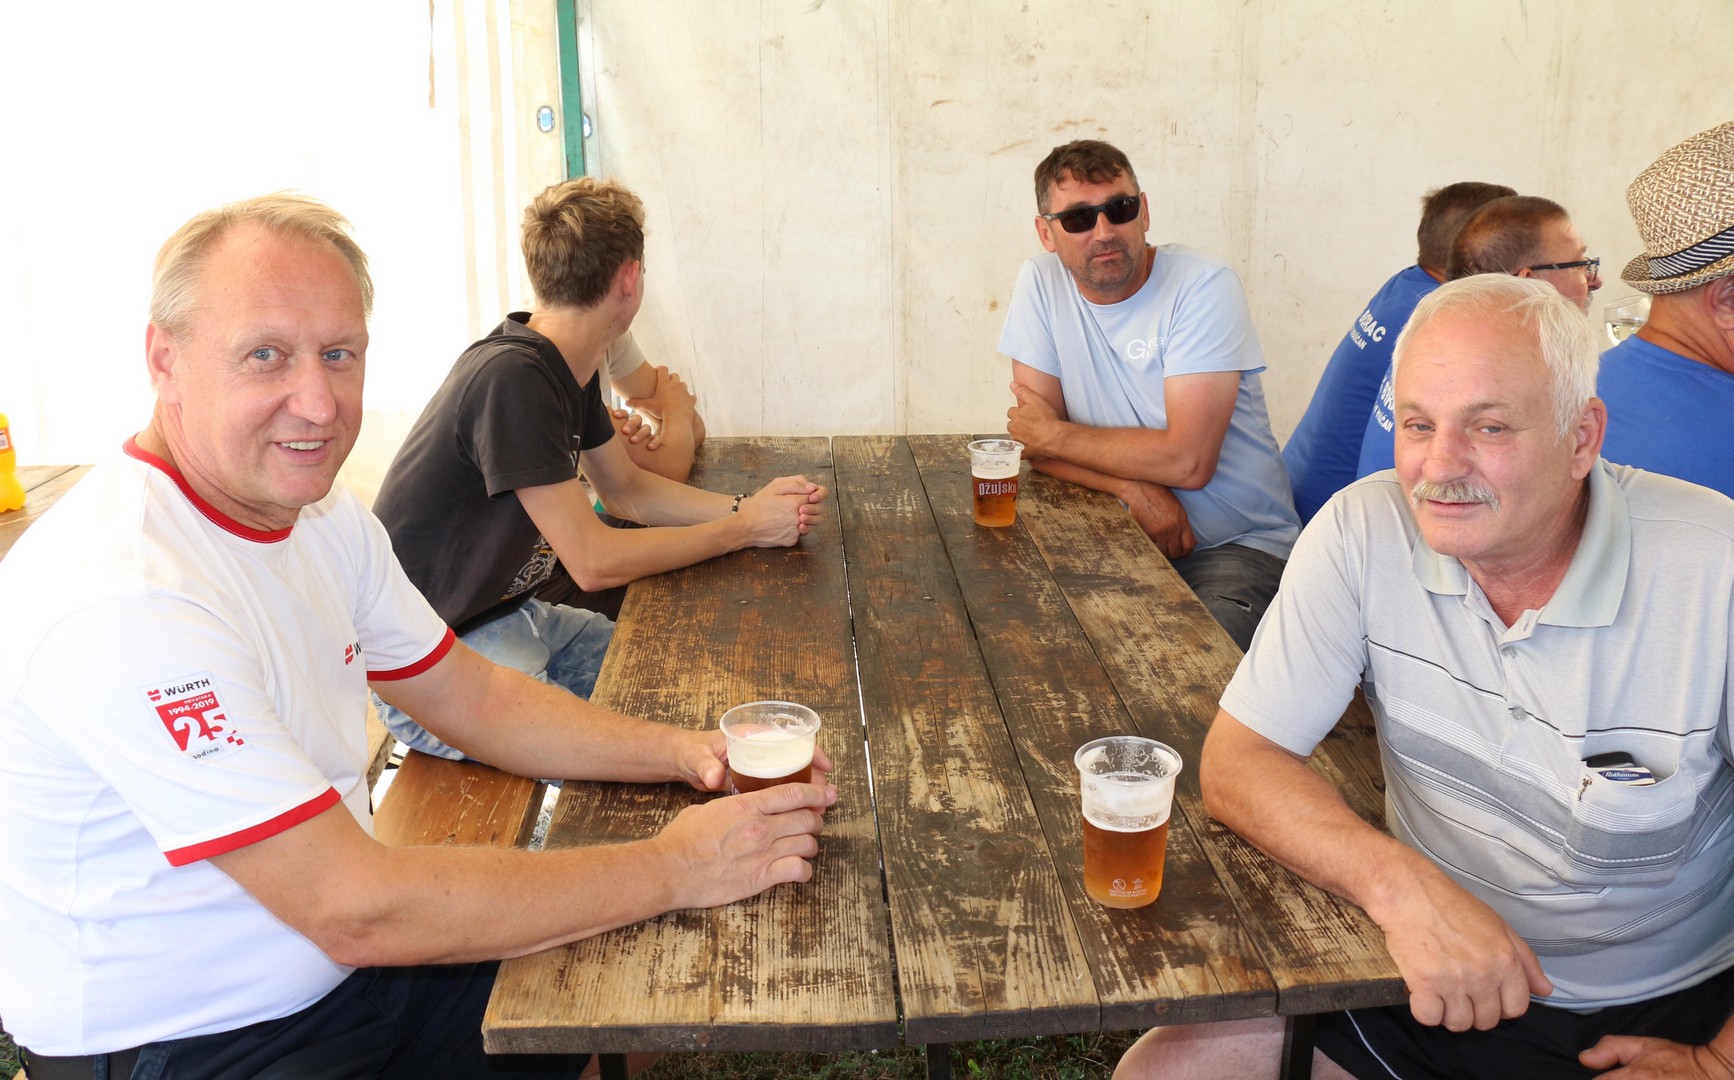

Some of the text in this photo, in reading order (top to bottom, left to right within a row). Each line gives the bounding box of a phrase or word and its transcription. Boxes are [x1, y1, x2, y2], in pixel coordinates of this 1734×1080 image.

[163, 678, 211, 697] WÜRTH
[167, 698, 215, 716] 1994-2019
[173, 708, 229, 751] 25
